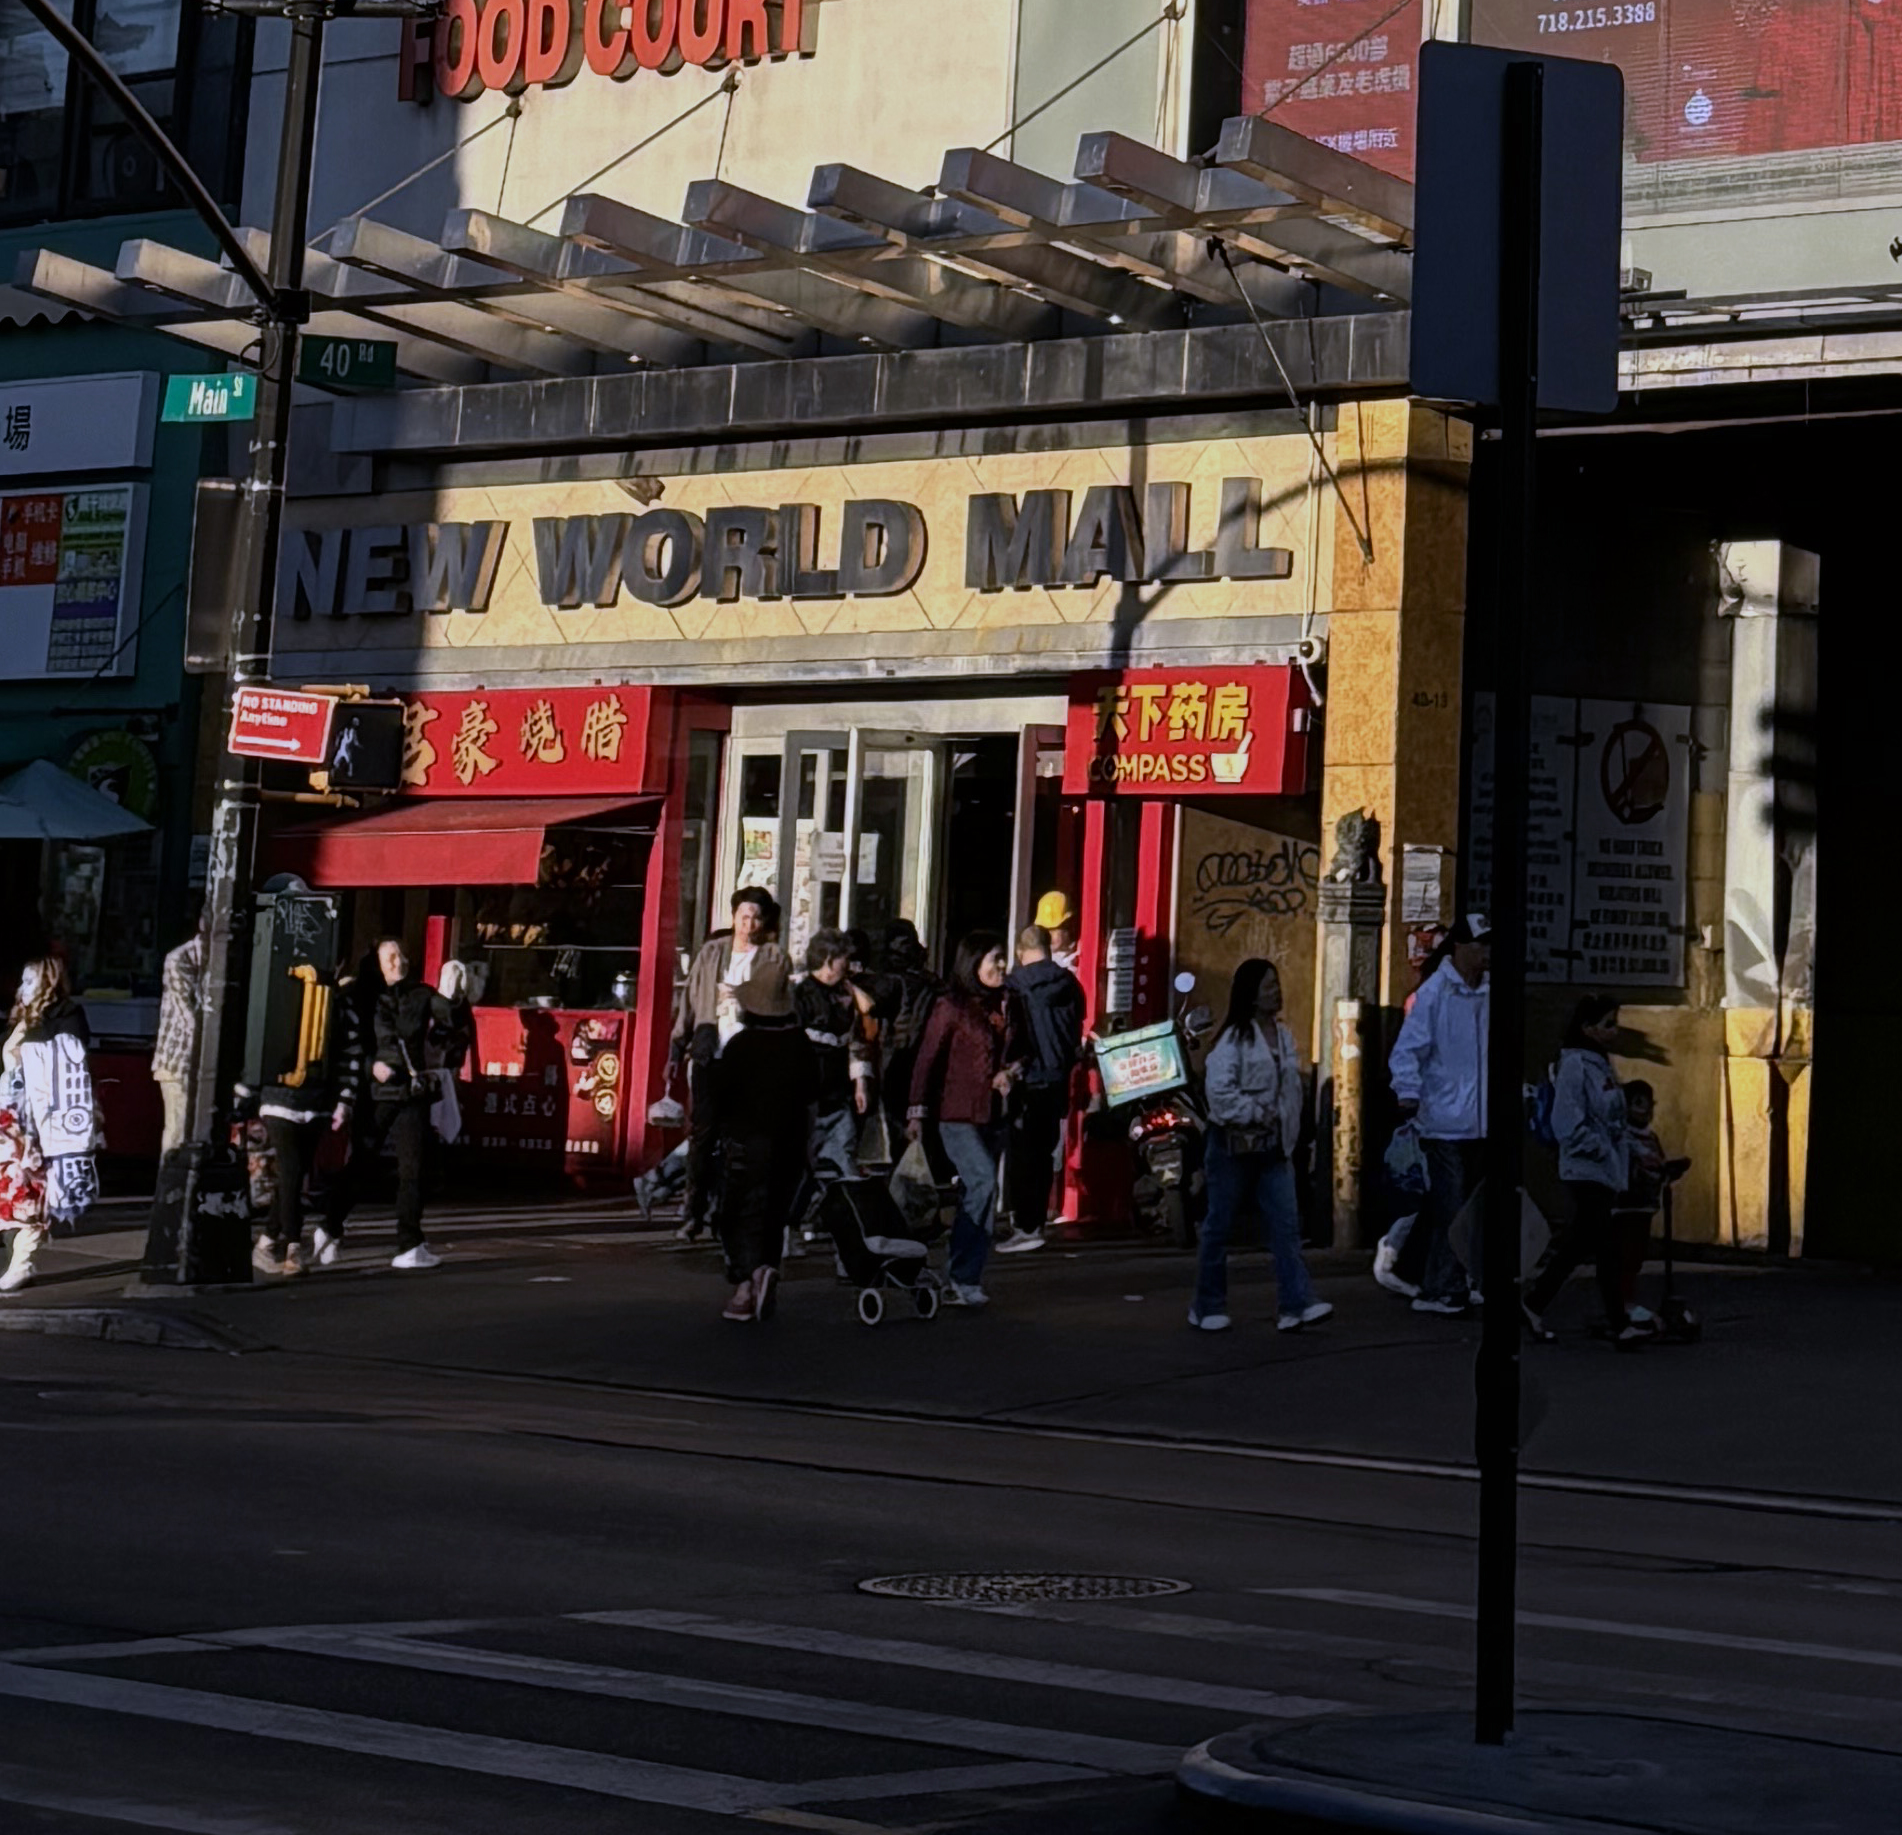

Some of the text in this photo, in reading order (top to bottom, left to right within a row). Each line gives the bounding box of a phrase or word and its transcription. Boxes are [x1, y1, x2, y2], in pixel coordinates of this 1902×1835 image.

[1537, 1, 1656, 35] 718.215.3388
[320, 342, 375, 377] 40 Rd
[188, 380, 229, 416] Main
[278, 476, 1294, 621] NEW WORLD MALL
[239, 709, 288, 727] Anytime
[241, 695, 318, 715] NO STANDING
[1093, 681, 1250, 743] 天下药房
[1088, 752, 1207, 784] COMPASS
